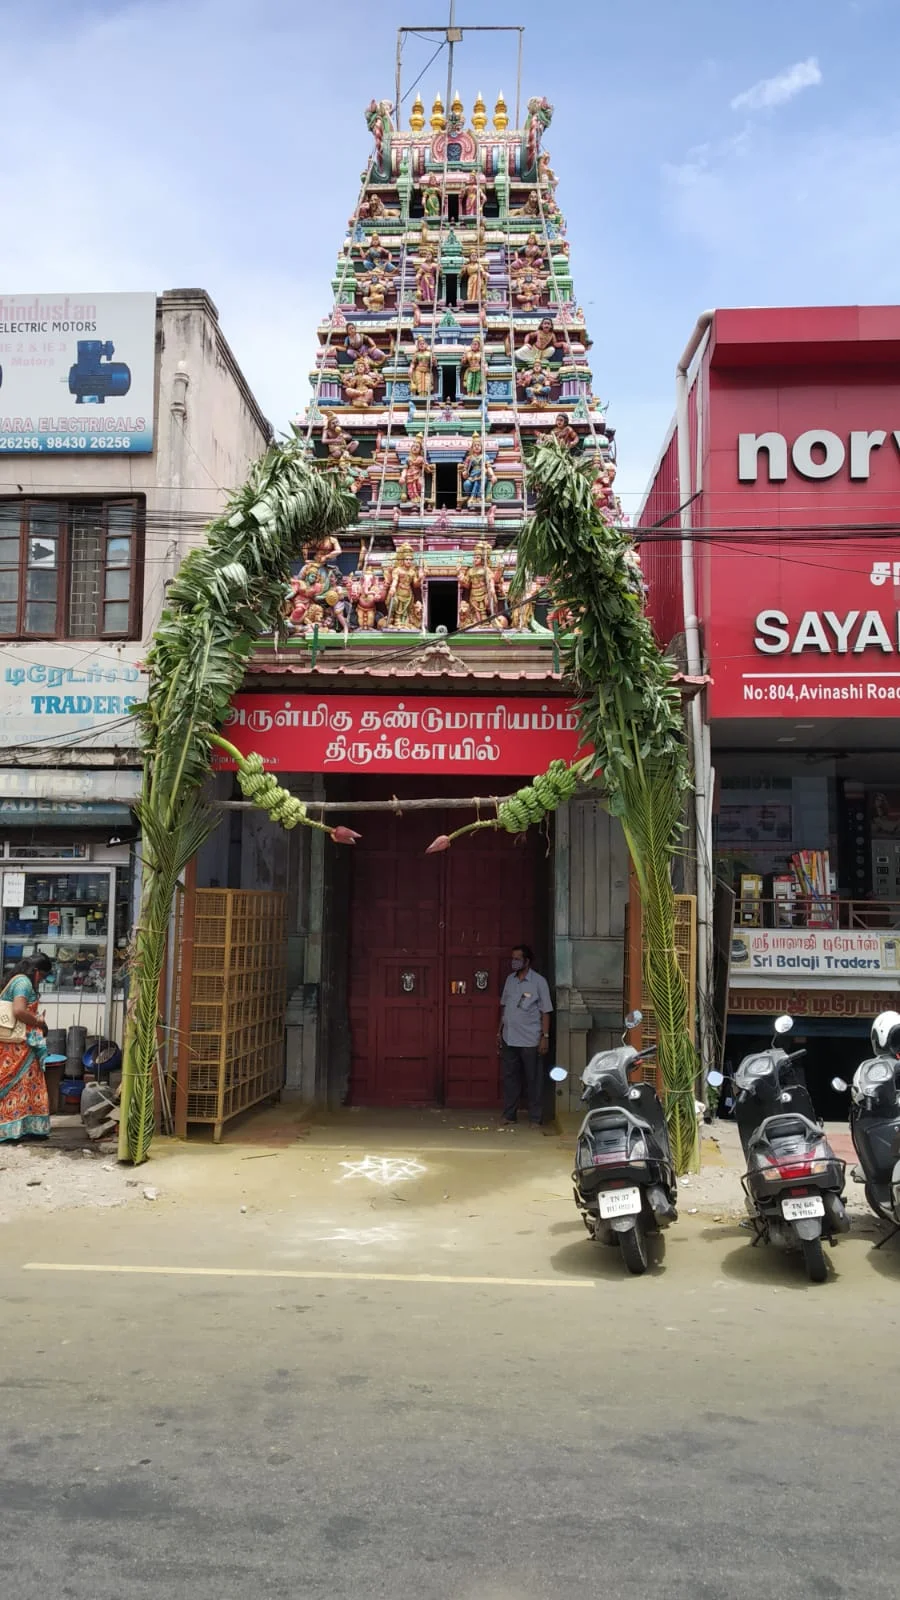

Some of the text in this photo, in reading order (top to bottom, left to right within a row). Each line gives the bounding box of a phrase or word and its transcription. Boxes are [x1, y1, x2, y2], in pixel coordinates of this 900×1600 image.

[0, 321, 97, 333] ELECTRIC MOTORS
[0, 416, 146, 433] ARA ELECTRICALS
[46, 437, 87, 449] 98430
[90, 436, 131, 449] 26256
[754, 610, 900, 654] SAYA
[31, 695, 136, 715] TRADERS
[223, 701, 580, 734] அருள்மிகு தண்டுமாரியம்ம
[323, 734, 501, 765] திருக்கோயில்
[772, 934, 817, 951] பாலாஜி
[753, 955, 880, 970] Sri Balaji Traders
